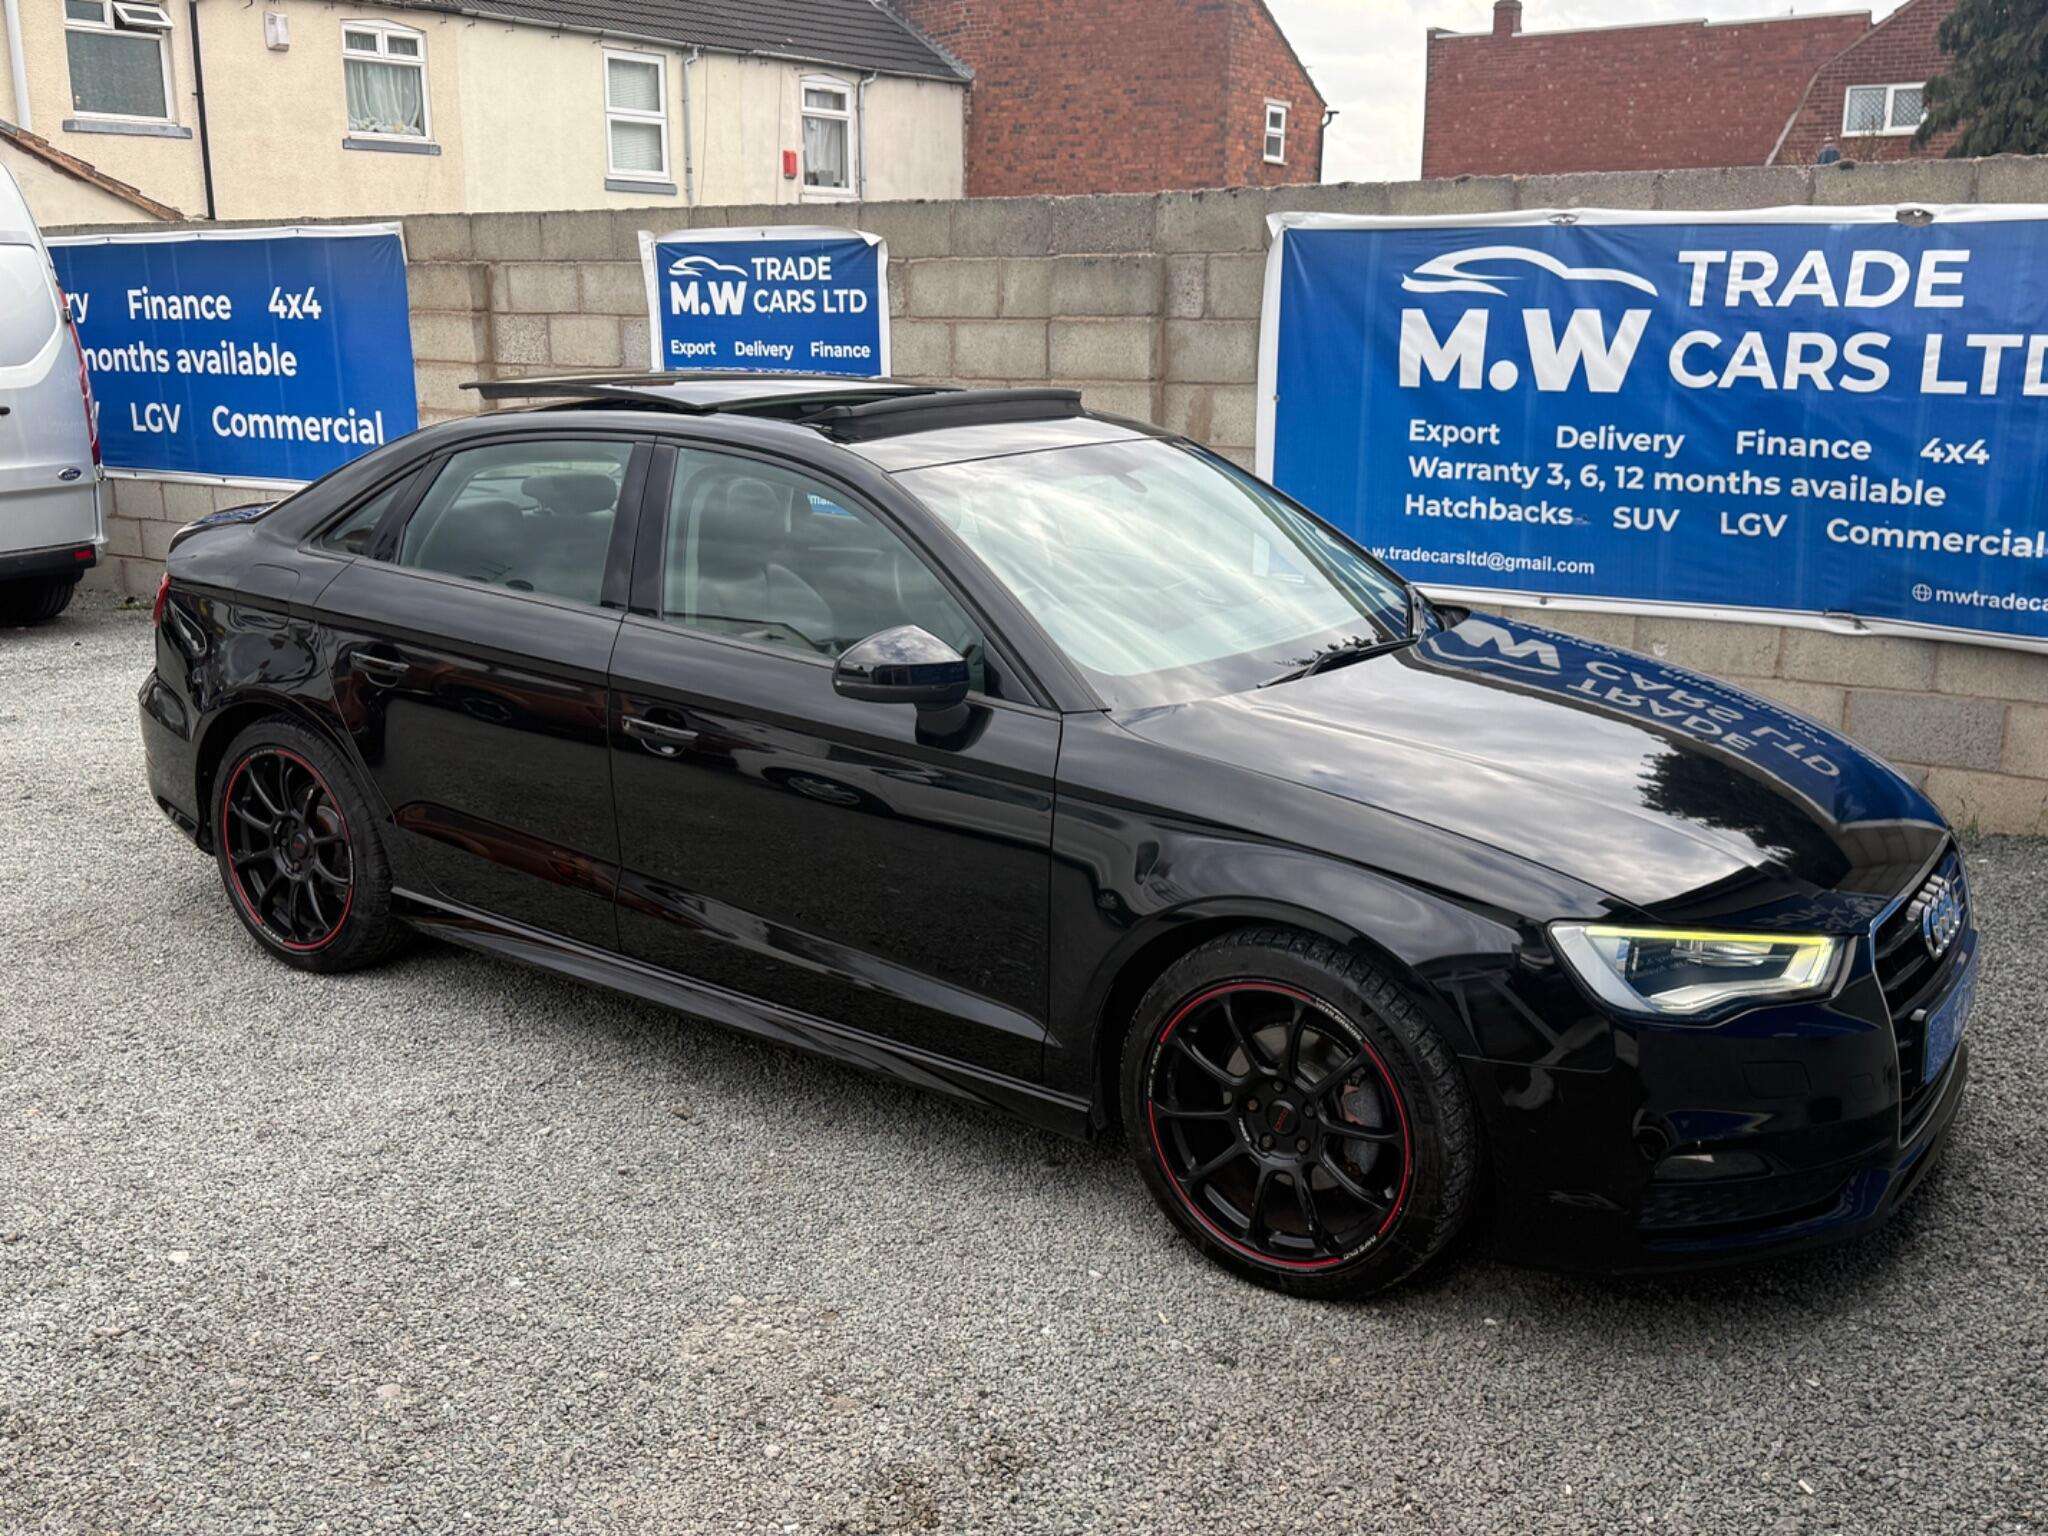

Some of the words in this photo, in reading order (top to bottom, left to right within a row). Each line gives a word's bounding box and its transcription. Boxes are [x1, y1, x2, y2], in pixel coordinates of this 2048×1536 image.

[751, 256, 832, 281] TRADE
[1678, 250, 1970, 308] TRADE
[127, 286, 231, 320] Finance
[268, 287, 322, 319] 4x4
[670, 281, 747, 315] M.W
[753, 289, 816, 314] CARS
[822, 289, 868, 313] LTD
[177, 340, 297, 376] available
[671, 340, 716, 358] Export
[735, 340, 794, 361] Delivery
[811, 341, 871, 358] Finance
[1400, 308, 1652, 393] M.W
[1669, 330, 1891, 393] CARS
[131, 403, 180, 433] LGV
[213, 406, 384, 445] Commercial
[1409, 419, 1500, 447] Export
[1556, 425, 1685, 459] Delivery
[1736, 428, 1872, 460] Finance
[1920, 437, 1990, 465] 4x4
[1408, 455, 1539, 489] Warranty
[1546, 463, 1571, 489] 3,
[1580, 464, 1605, 492] 6,
[1614, 465, 1644, 490] 12
[1653, 470, 1781, 496] months
[1791, 474, 1946, 507] available
[1405, 494, 1573, 525] Hatchbacks
[1613, 506, 1680, 532] SUV
[1720, 511, 1788, 538] LGV
[1826, 518, 2044, 558] Commercial
[1363, 544, 1595, 574] w.tradecarsltd@gmail.com
